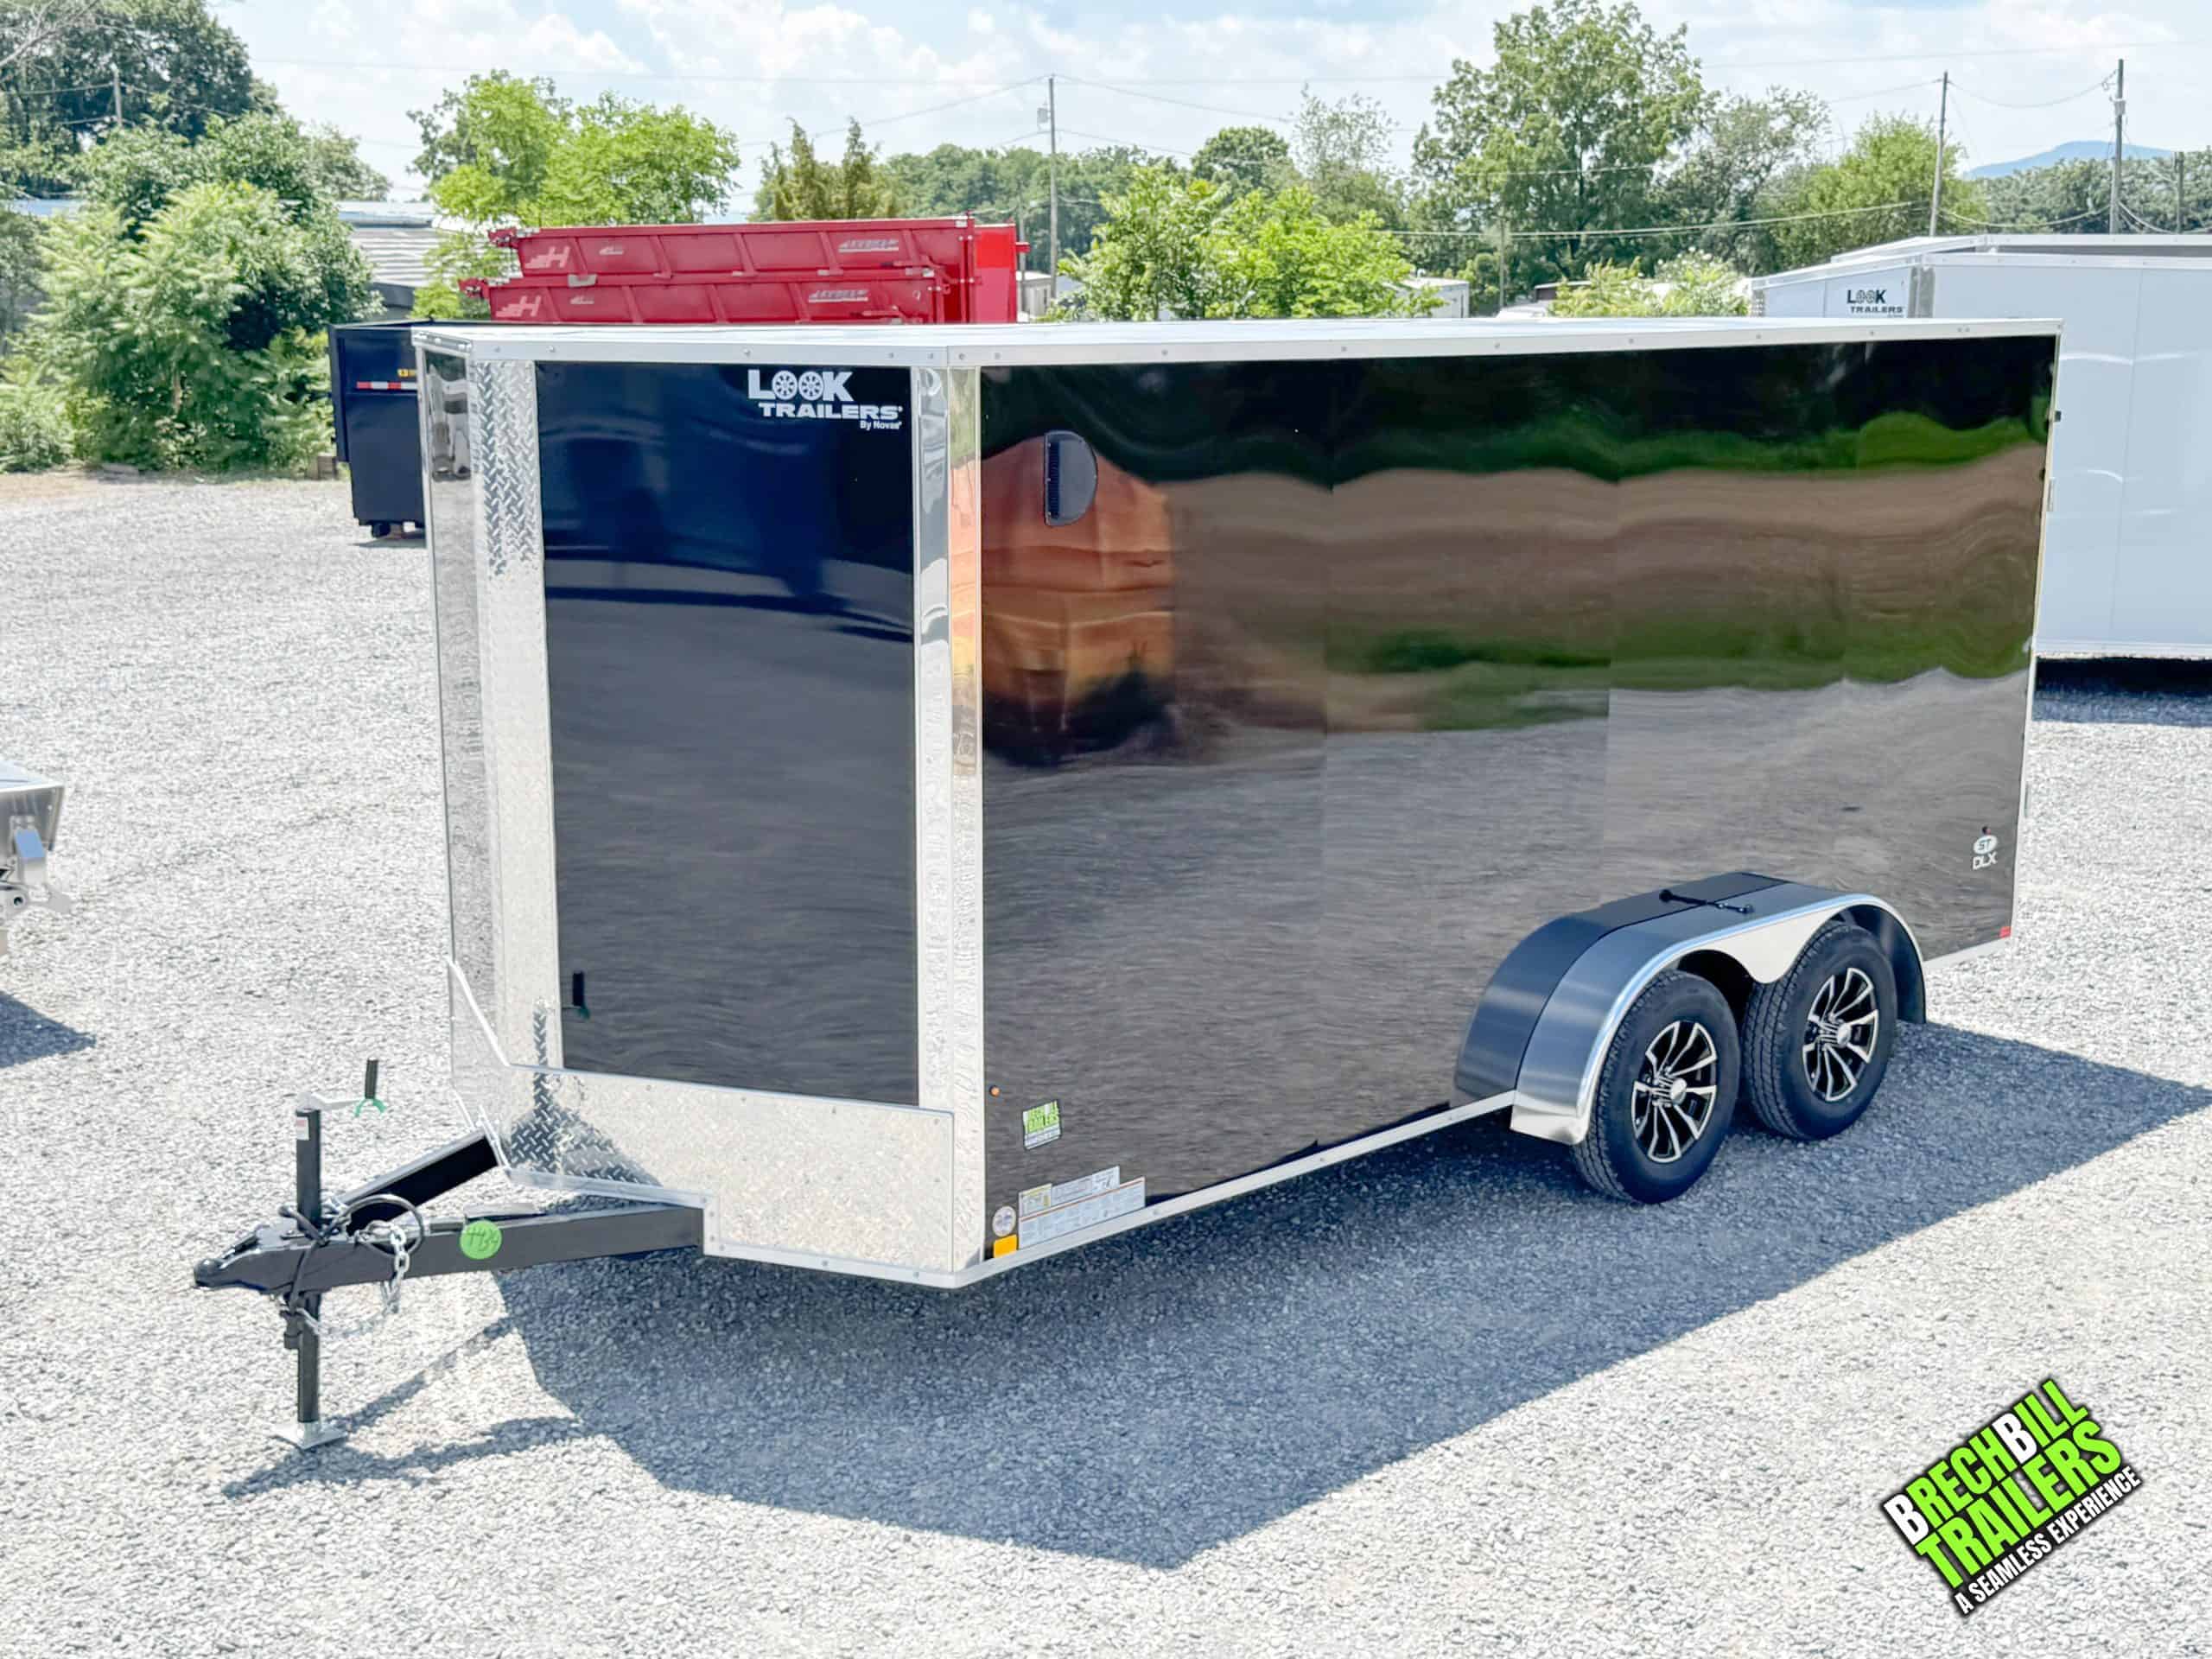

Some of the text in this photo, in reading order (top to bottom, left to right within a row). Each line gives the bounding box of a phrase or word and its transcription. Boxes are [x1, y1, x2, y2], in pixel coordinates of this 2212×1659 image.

[1847, 289, 1886, 304] LOOK
[747, 369, 855, 402] LOOK
[758, 402, 899, 420] TRAILERS
[1973, 851, 1998, 869] DLX
